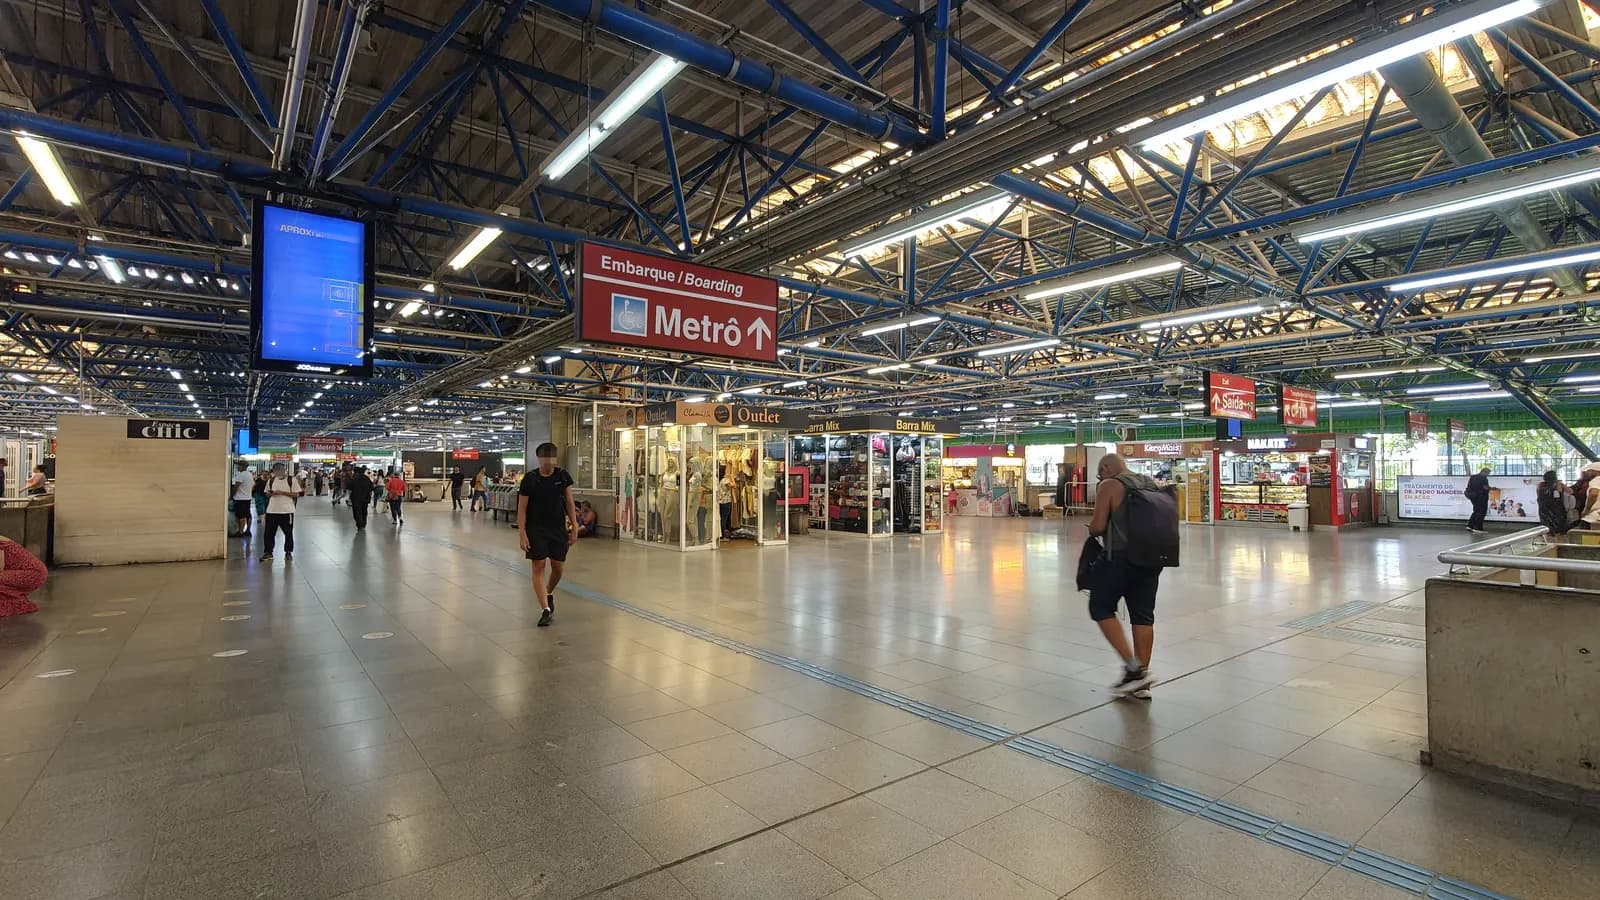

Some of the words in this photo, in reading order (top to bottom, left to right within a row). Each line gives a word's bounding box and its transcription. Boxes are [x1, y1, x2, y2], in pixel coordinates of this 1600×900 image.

[601, 255, 675, 282] Embarque
[677, 270, 684, 284] /
[684, 272, 744, 297] Boarding
[655, 304, 742, 347] Metrô
[646, 408, 668, 422] Outlet
[737, 407, 781, 424] Outlet
[825, 421, 840, 431] Mix
[896, 419, 919, 431] Barra
[921, 420, 936, 432] Mix
